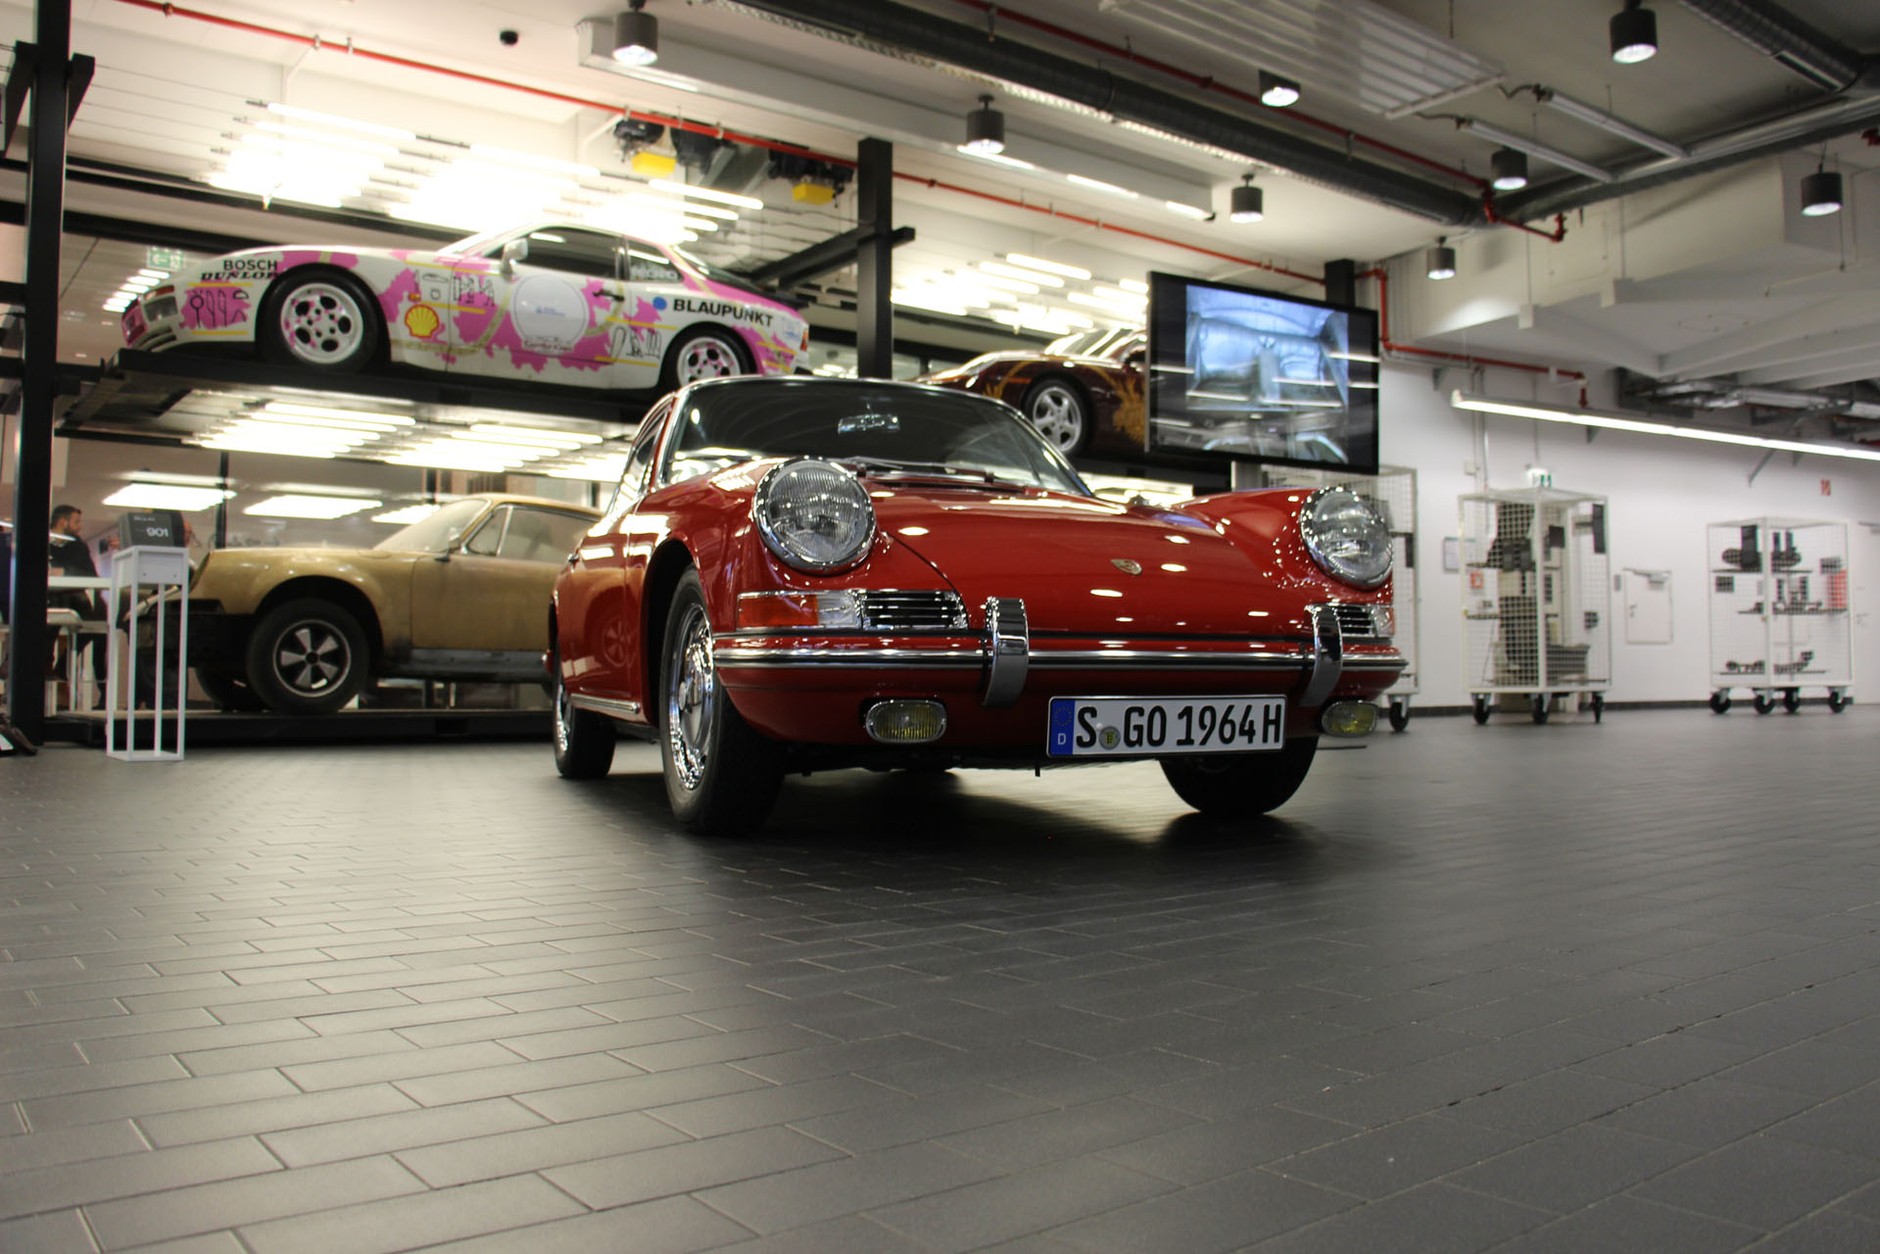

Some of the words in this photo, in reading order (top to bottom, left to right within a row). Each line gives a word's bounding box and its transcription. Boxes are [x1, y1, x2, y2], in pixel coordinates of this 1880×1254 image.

[223, 259, 277, 271] BOSCH
[673, 299, 773, 327] BLAUPUNKT
[146, 527, 169, 537] 901
[1076, 706, 1097, 748] S
[1123, 705, 1167, 747] GO
[1057, 732, 1067, 746] D
